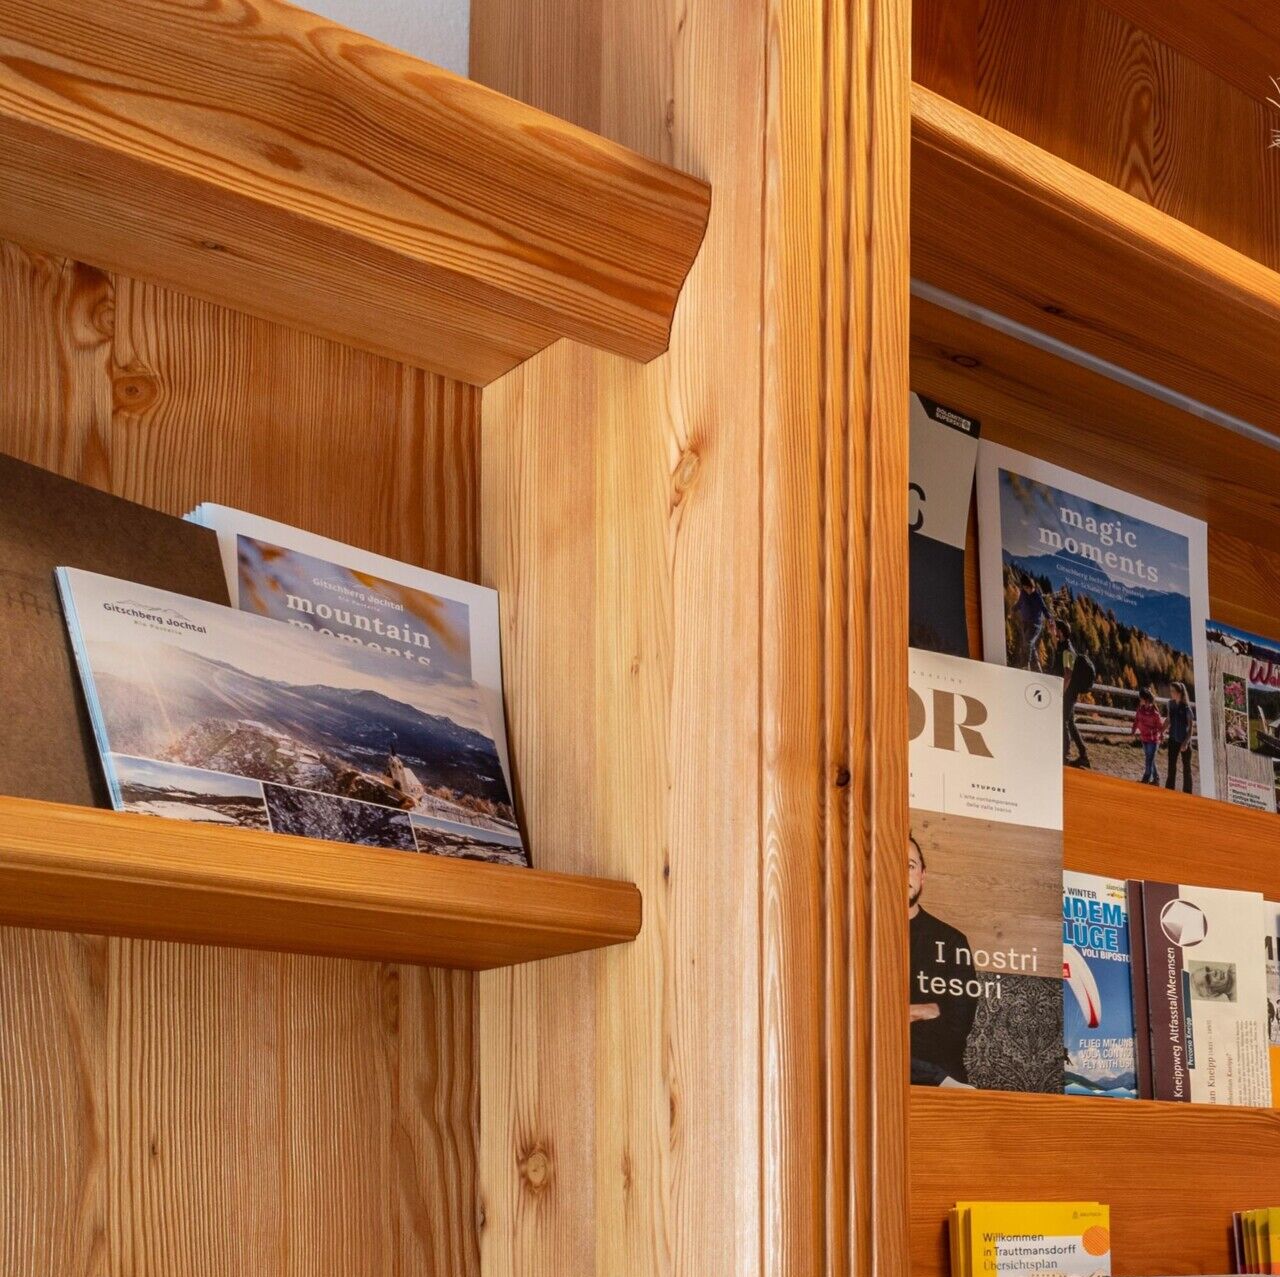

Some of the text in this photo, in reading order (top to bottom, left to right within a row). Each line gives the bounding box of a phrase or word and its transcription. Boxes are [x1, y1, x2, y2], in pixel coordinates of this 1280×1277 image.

[1060, 506, 1137, 548] magic
[1038, 526, 1159, 583] moments
[313, 577, 404, 613] Gitschberg Jochtal
[103, 602, 207, 635] Gitschberg Jochtal
[286, 592, 432, 650] mountain
[971, 783, 1007, 794] STUPORE
[1068, 886, 1098, 899] WINTER
[935, 940, 1038, 972] I nostri
[1081, 948, 1099, 960] VOLI
[916, 970, 1001, 999] tesori
[1165, 946, 1184, 1098] Kneippweg Altfasstal/Meransen
[1080, 1038, 1100, 1048] FLIEG
[1206, 1057, 1217, 1088] Kneipp
[983, 1232, 1044, 1243] Willkommen
[983, 1244, 1076, 1257] in Trauttmansdorff
[983, 1258, 1058, 1271] Übersichtsplan
